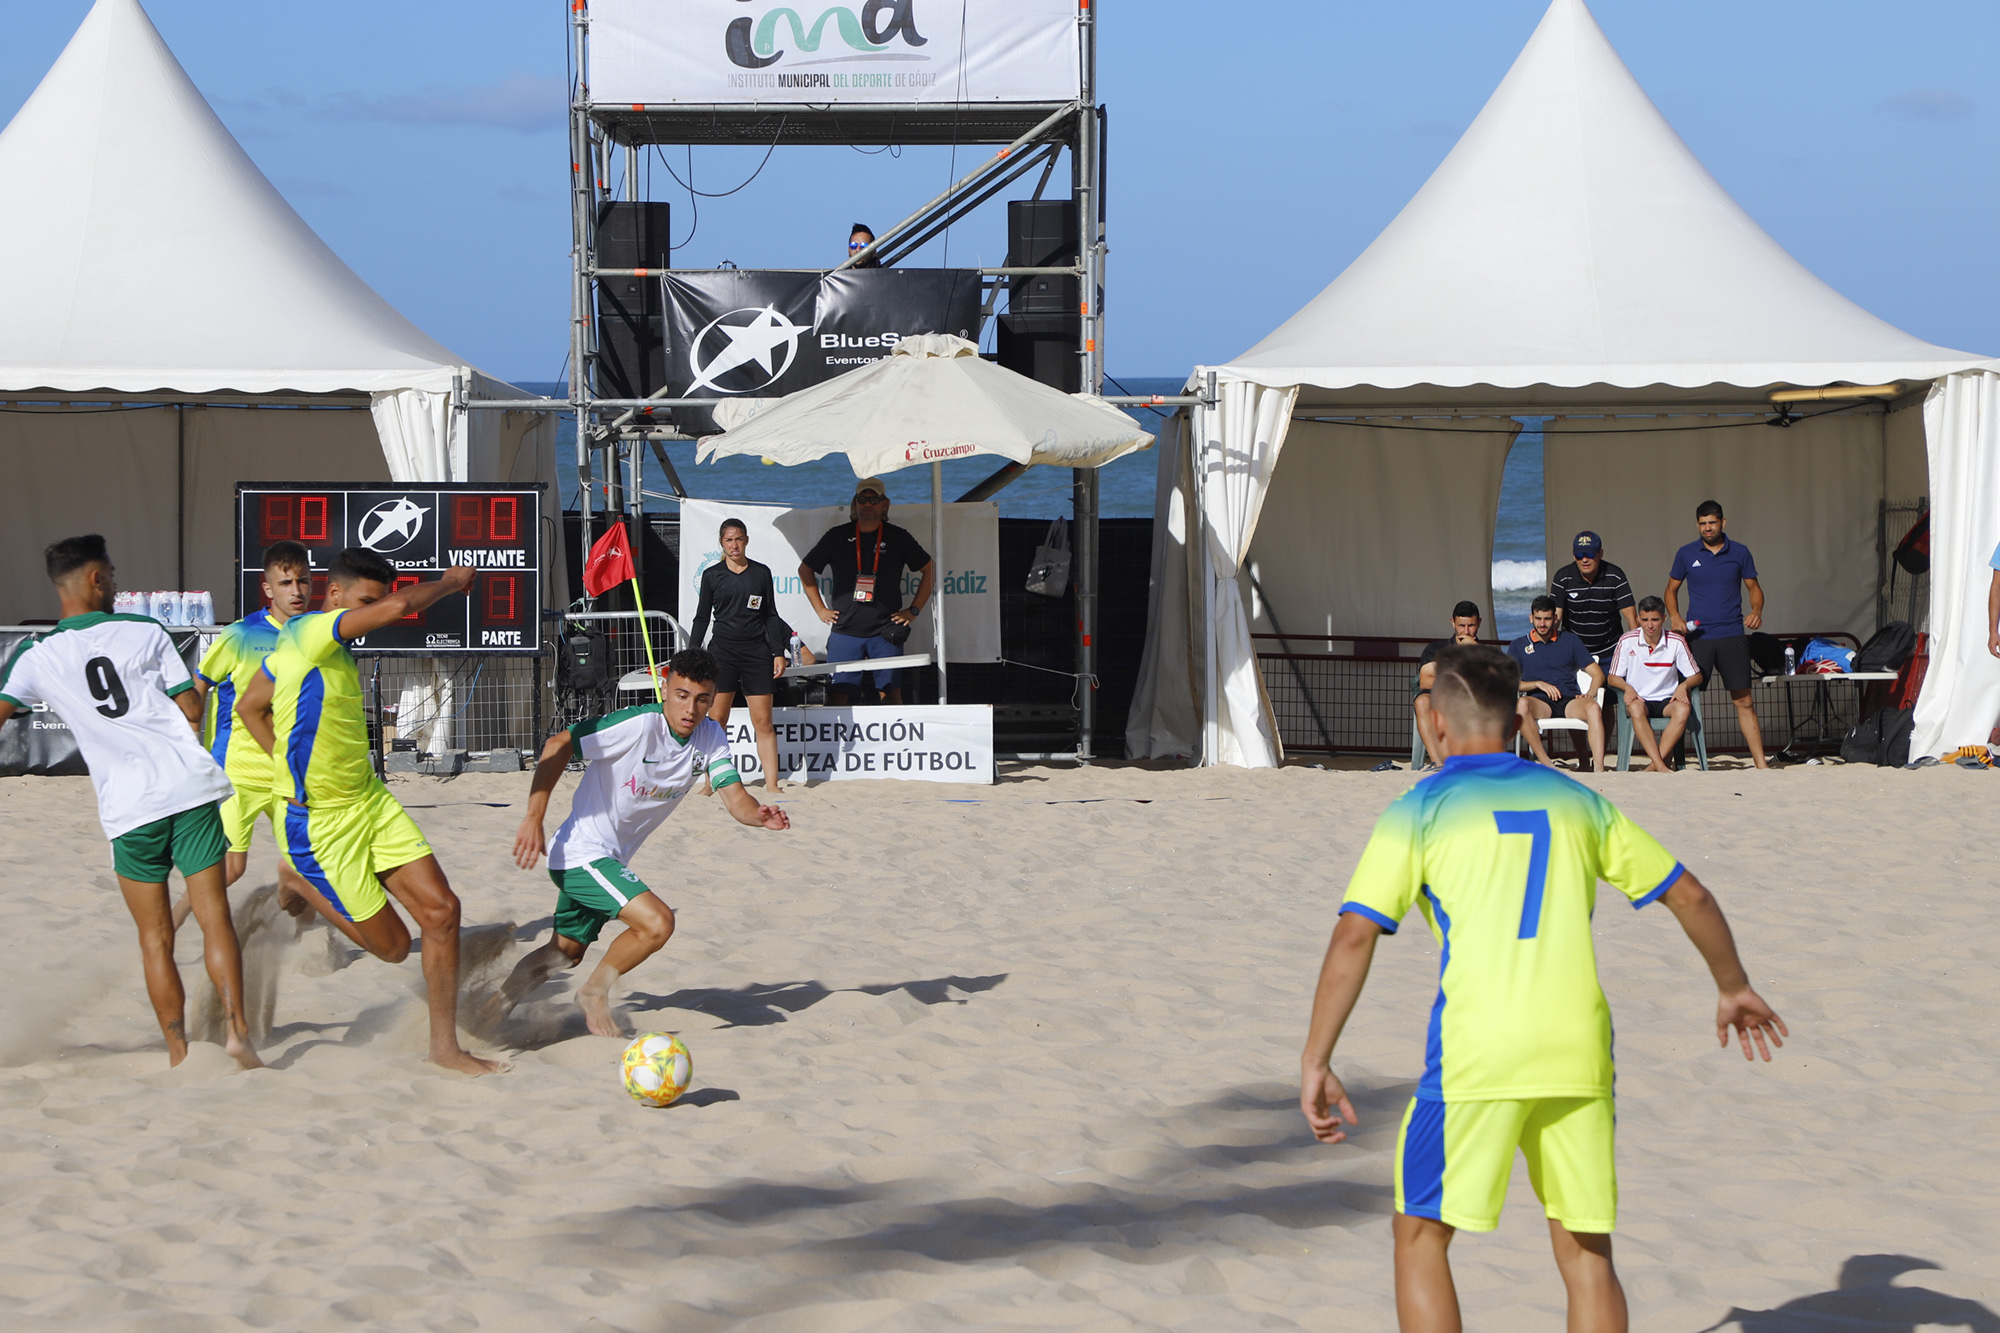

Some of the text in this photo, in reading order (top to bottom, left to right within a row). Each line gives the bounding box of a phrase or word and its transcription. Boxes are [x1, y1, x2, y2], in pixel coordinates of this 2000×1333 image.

[728, 70, 937, 88] INSTITUTO MUNICIPAL DEL DEPORTE DE CÁDIZ
[923, 443, 976, 460] Cruzcampo
[300, 497, 328, 540] 0
[490, 497, 516, 540] 0
[448, 549, 526, 567] VISITANTE
[943, 570, 987, 595] ádiz
[481, 630, 522, 645] PARTE
[85, 655, 130, 719] 9
[772, 718, 925, 743] FEDERACIÓN
[845, 752, 876, 772] DE
[884, 748, 977, 771] FÚTBOL
[1492, 809, 1552, 940] 7
